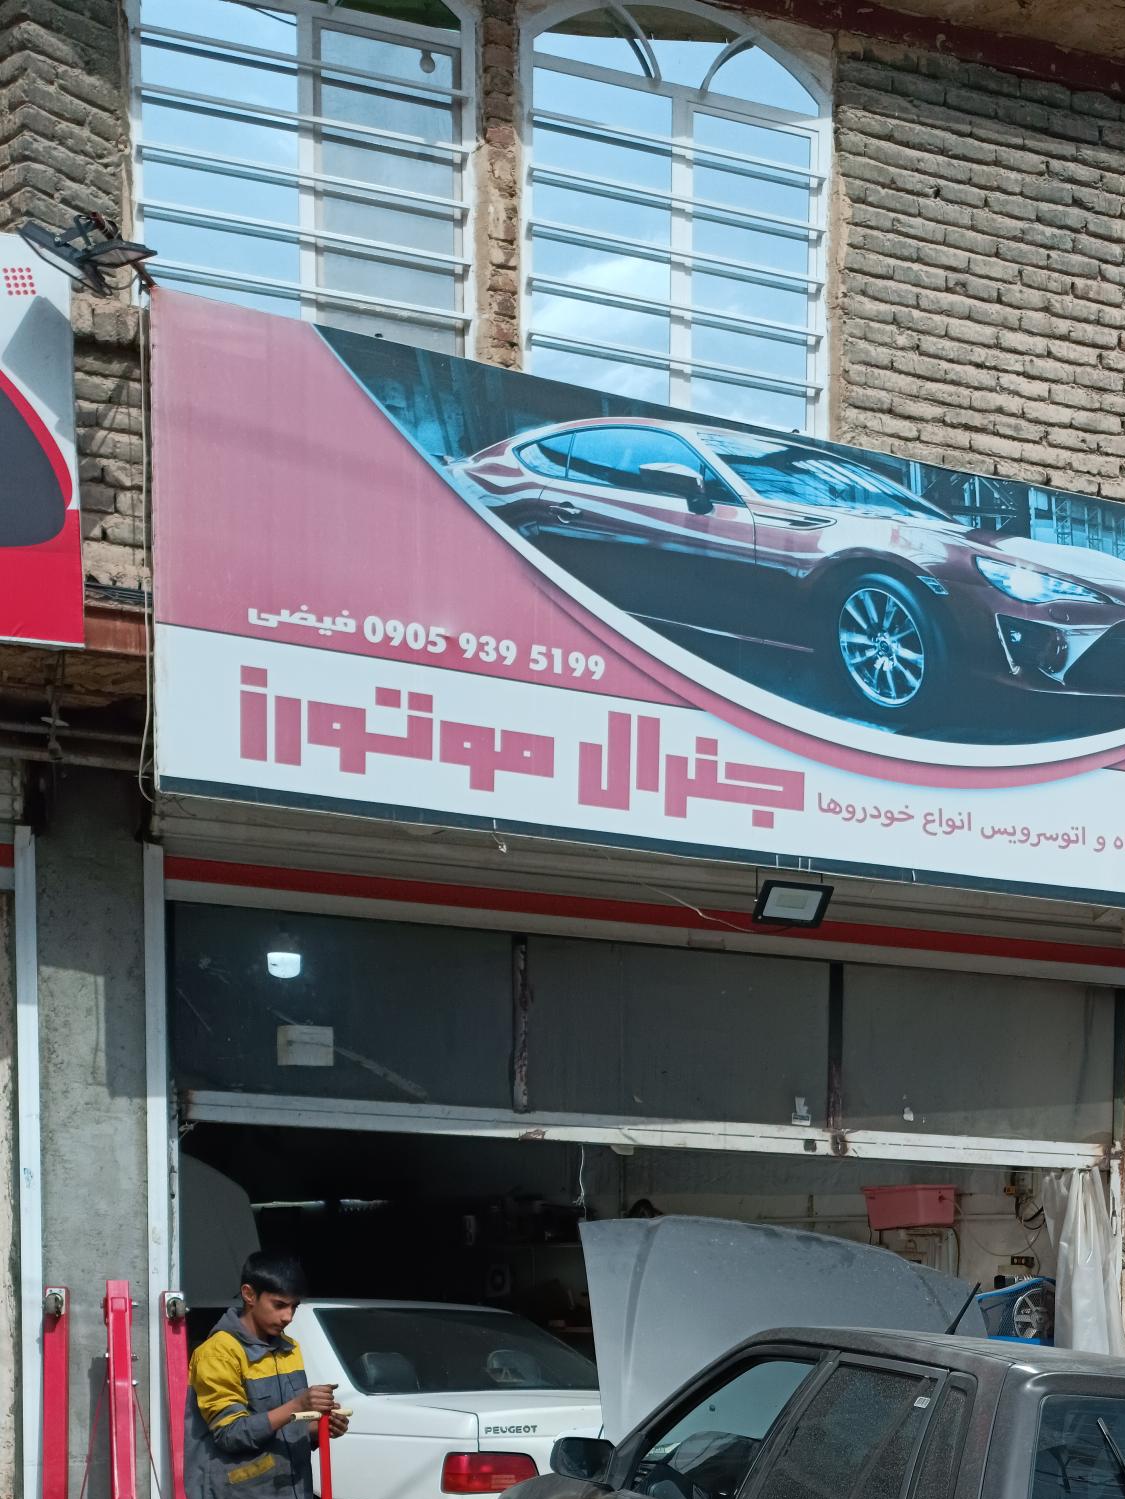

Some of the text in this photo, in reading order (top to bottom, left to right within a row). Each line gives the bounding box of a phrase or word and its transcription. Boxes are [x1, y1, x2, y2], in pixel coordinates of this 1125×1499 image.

[247, 604, 606, 681] 0905 939 5199 فیضی
[239, 664, 806, 829] جنرال موتورز
[817, 792, 915, 827] خودروها
[921, 808, 972, 836] انواع
[980, 825, 1086, 848] اتوسرویس
[1093, 834, 1106, 852] و
[484, 1424, 538, 1435] PEUGEOT
